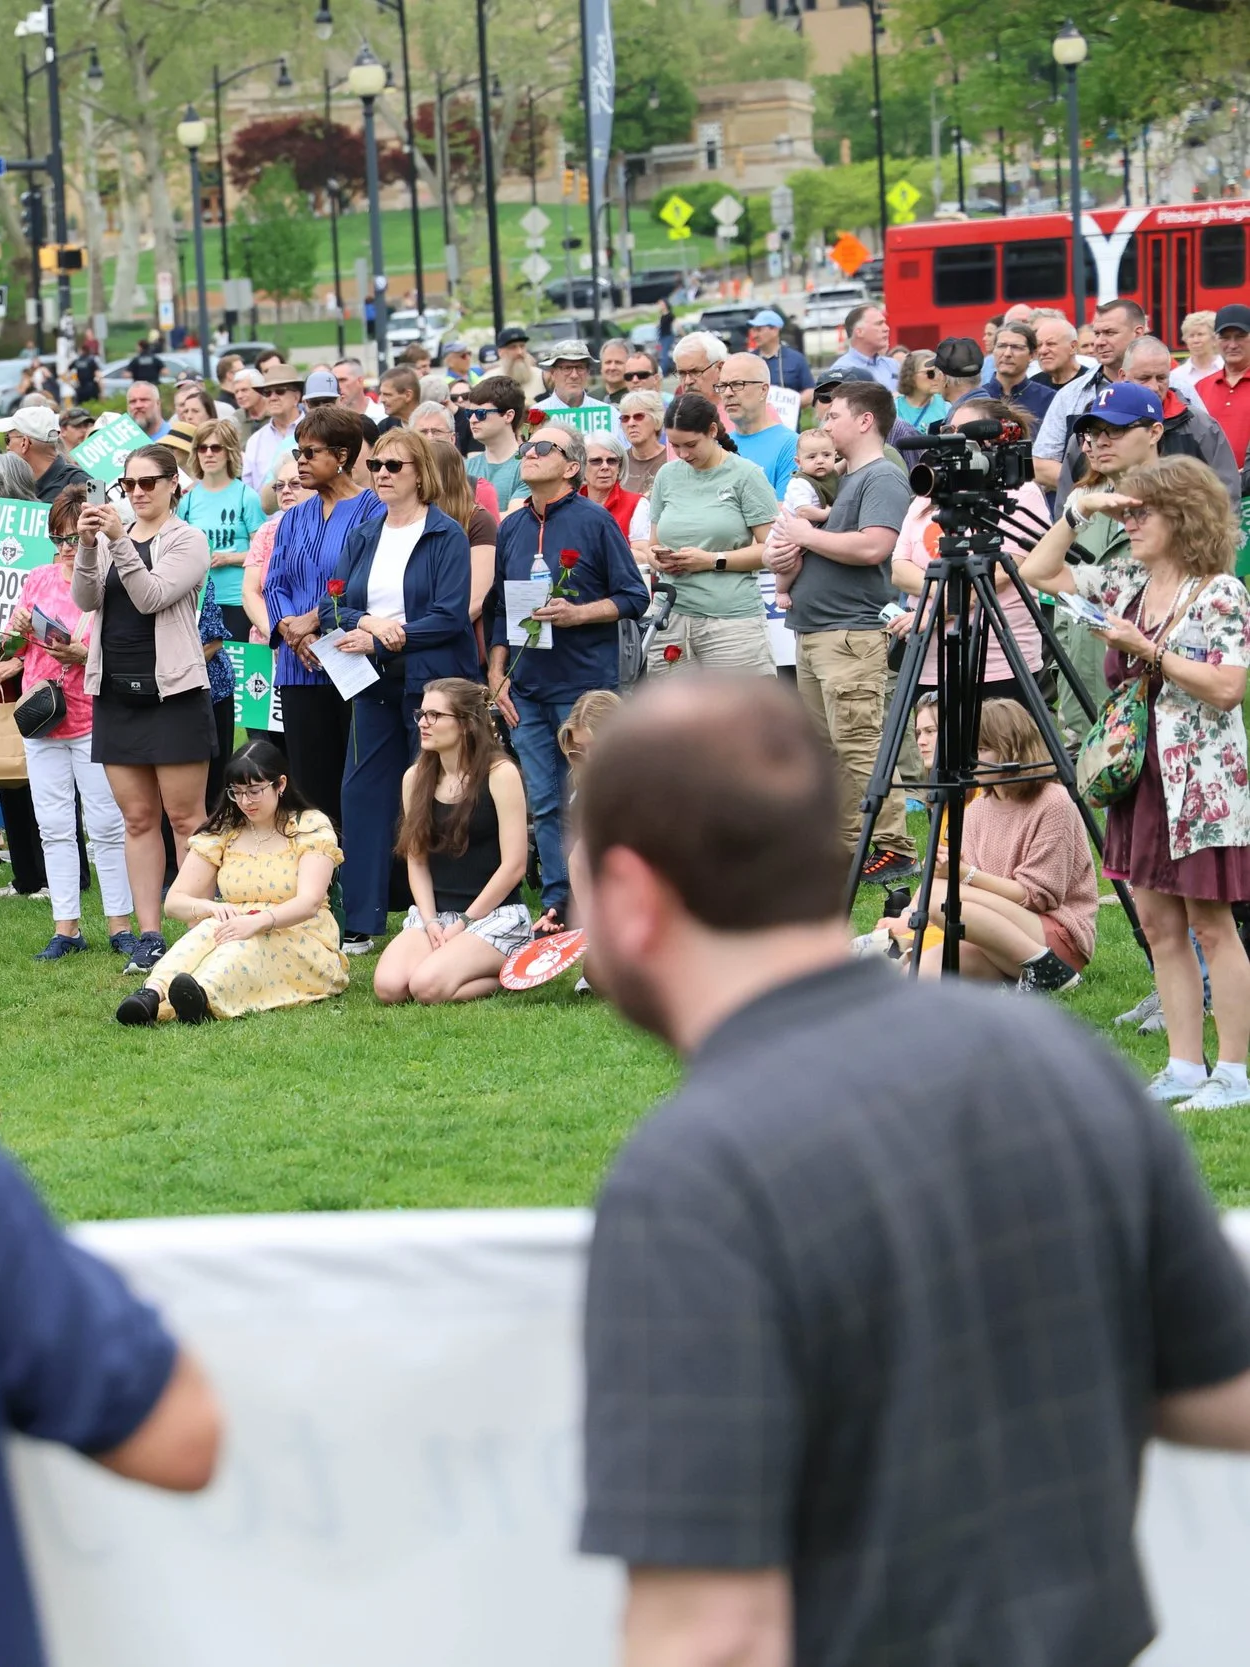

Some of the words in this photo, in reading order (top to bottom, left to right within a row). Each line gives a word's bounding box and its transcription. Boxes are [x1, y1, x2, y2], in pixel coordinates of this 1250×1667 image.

[1098, 388, 1114, 406] T
[580, 410, 608, 434] LIFE
[75, 434, 114, 469] LOVE
[105, 418, 141, 446] LIFE
